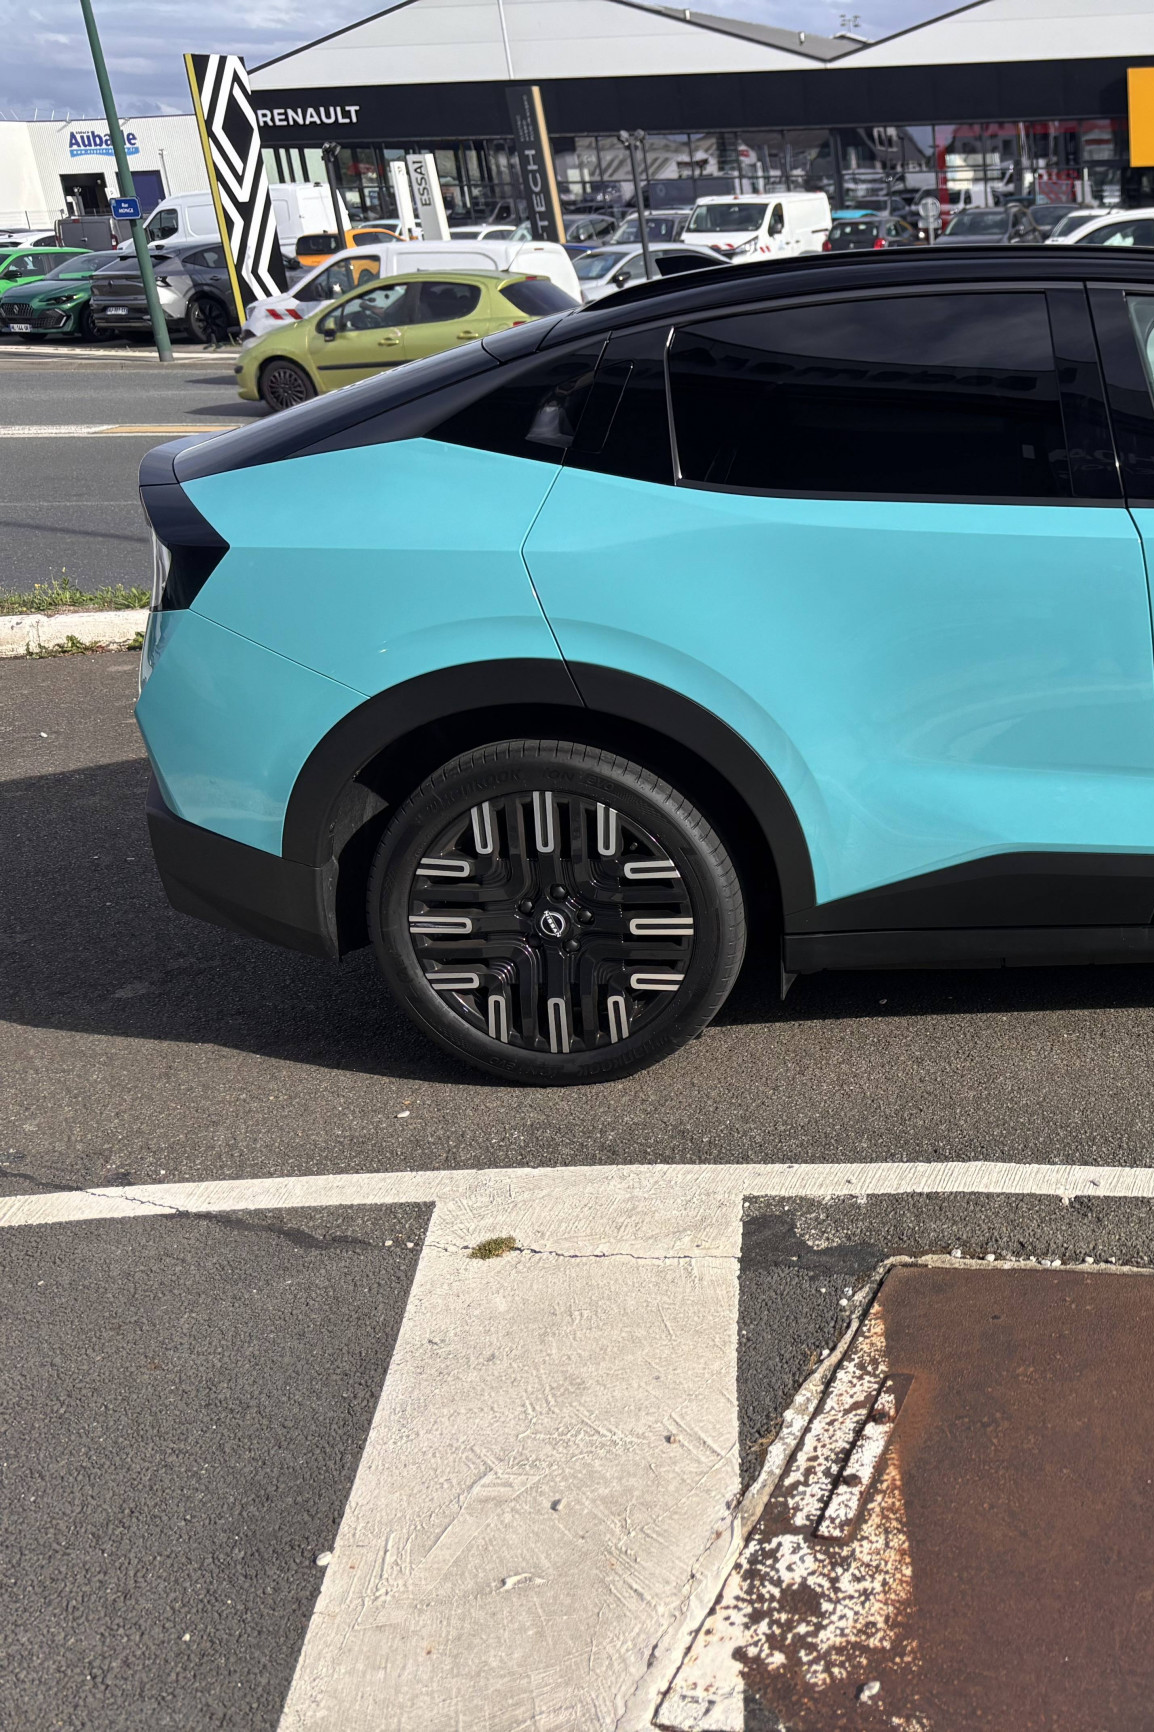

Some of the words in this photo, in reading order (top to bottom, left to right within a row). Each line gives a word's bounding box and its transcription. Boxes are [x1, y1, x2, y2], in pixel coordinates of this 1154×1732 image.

[256, 105, 360, 127] RENAULT
[411, 160, 432, 207] ESSAI
[524, 149, 549, 240] -TECH
[543, 909, 562, 938] NISSAN
